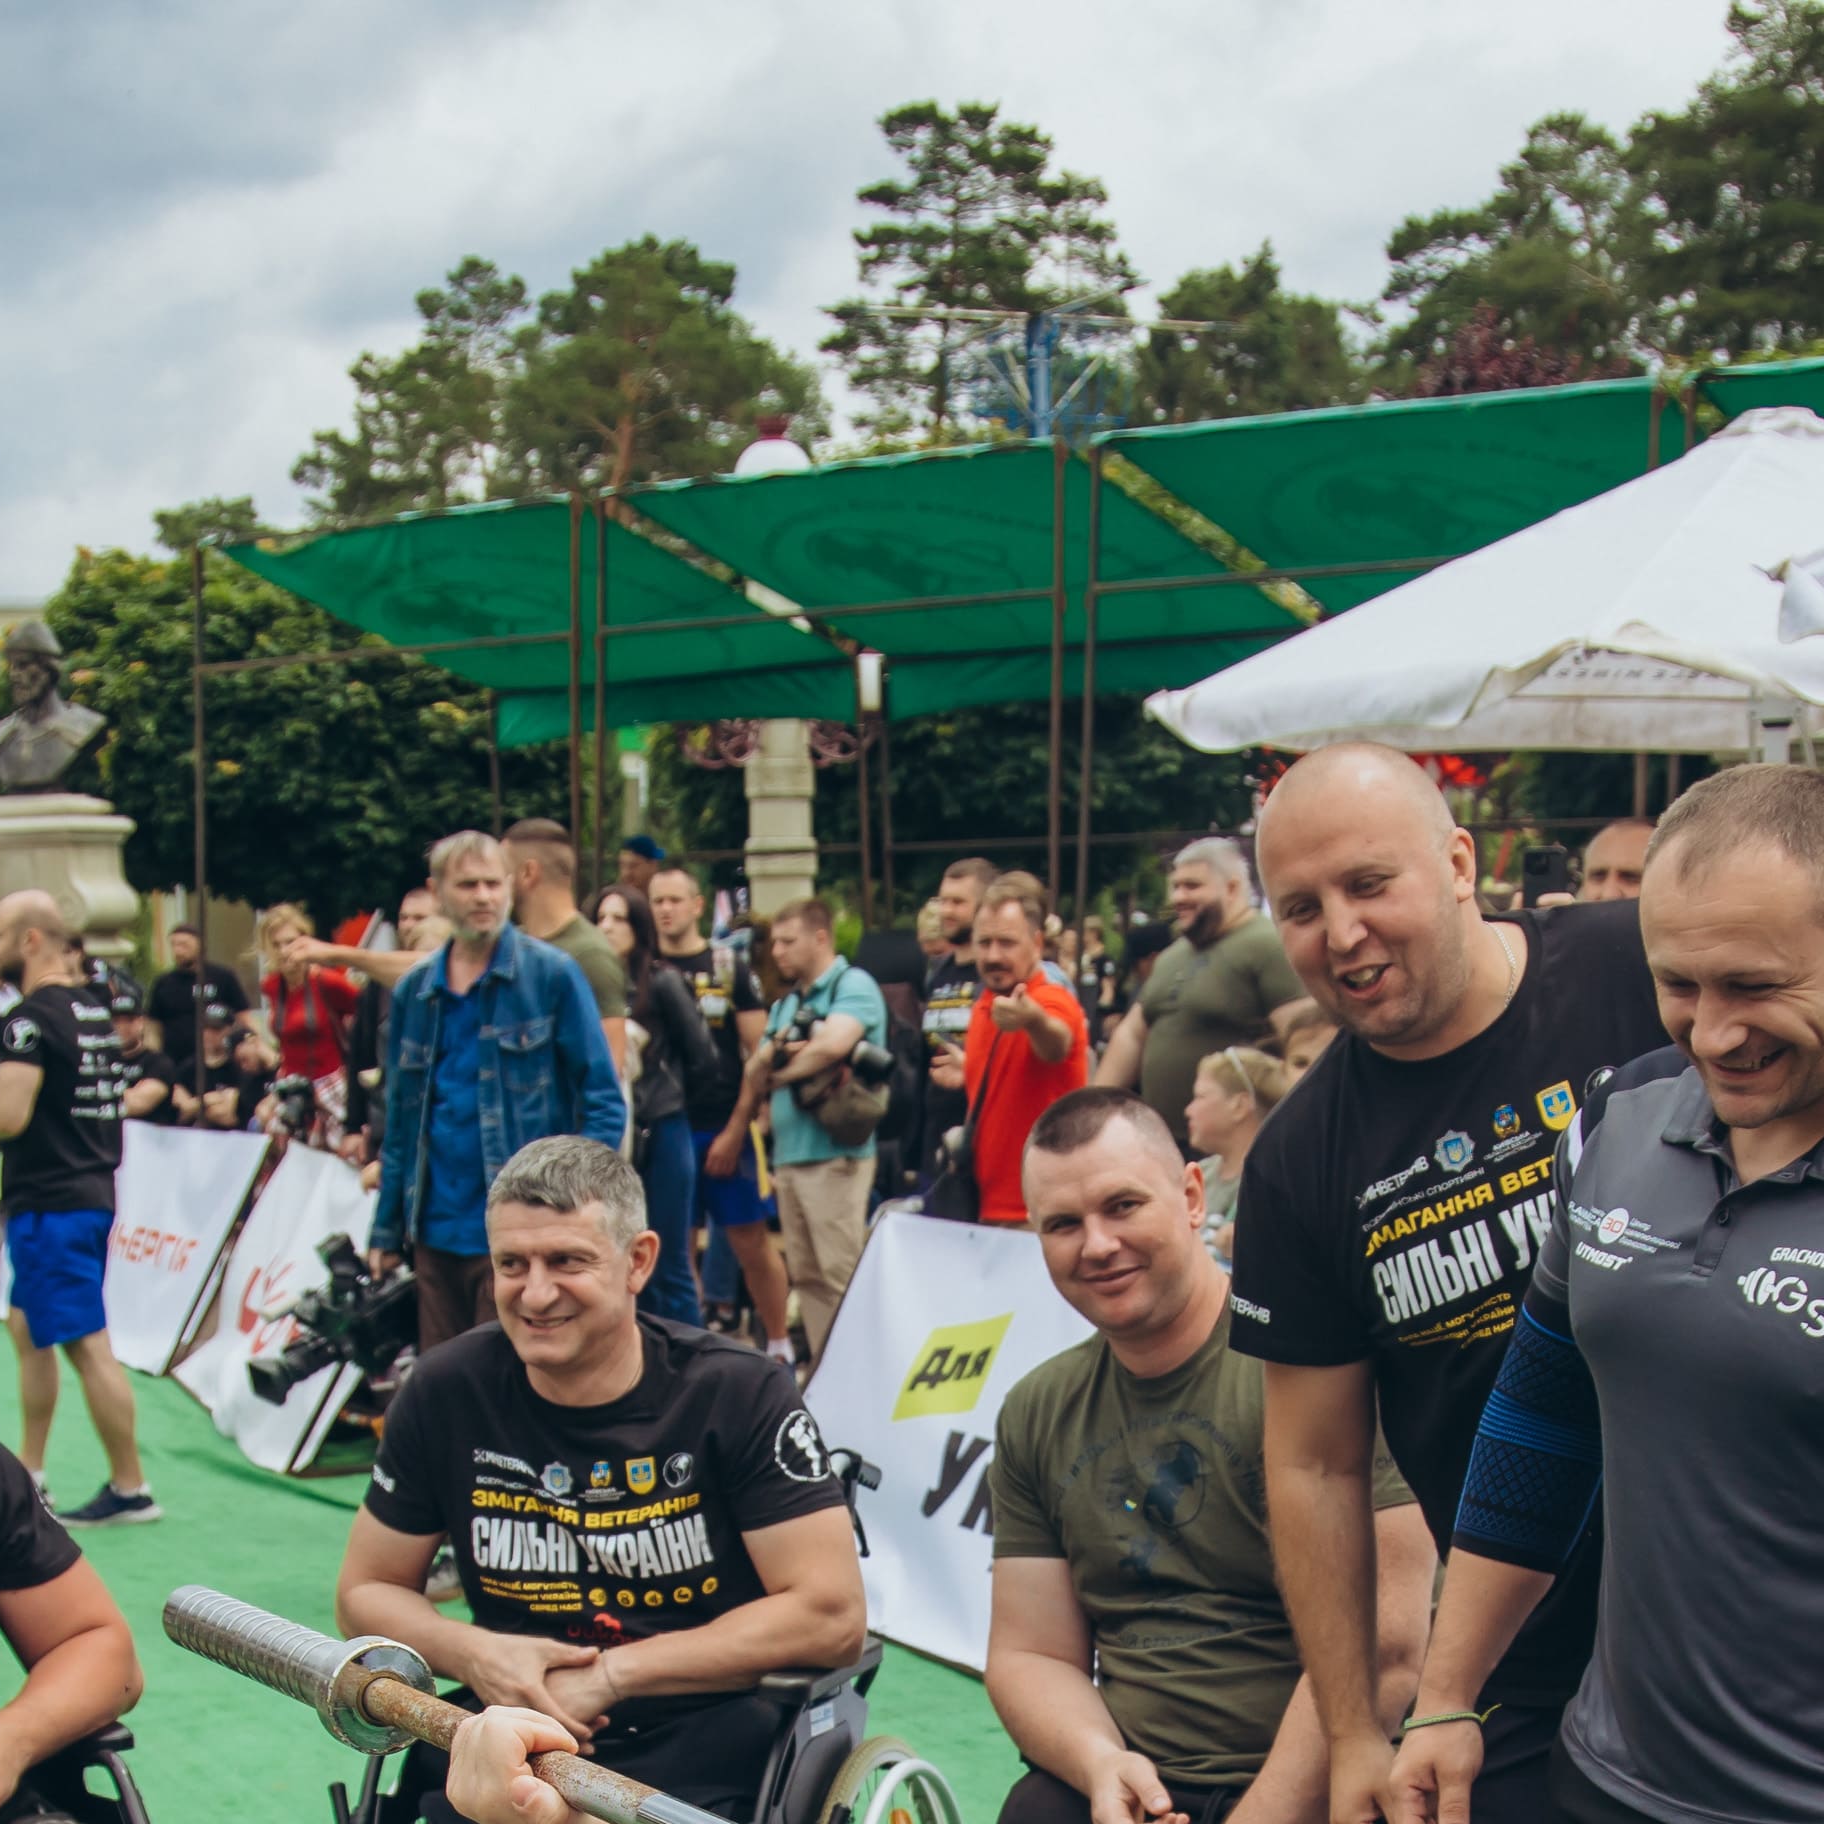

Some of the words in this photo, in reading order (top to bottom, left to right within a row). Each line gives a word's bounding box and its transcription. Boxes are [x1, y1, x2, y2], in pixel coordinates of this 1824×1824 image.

[1499, 1154, 1557, 1197] ВЕТ
[1602, 1217, 1625, 1234] 30
[1372, 1218, 1505, 1325] СИЛЬНІ
[1575, 1241, 1627, 1271] UTMOST
[908, 1345, 993, 1392] Для
[584, 1493, 701, 1529] ВЕТЕРАНІВ
[471, 1516, 578, 1574] СИЛЬНІ
[576, 1512, 715, 1579] УКРАЇНИ
